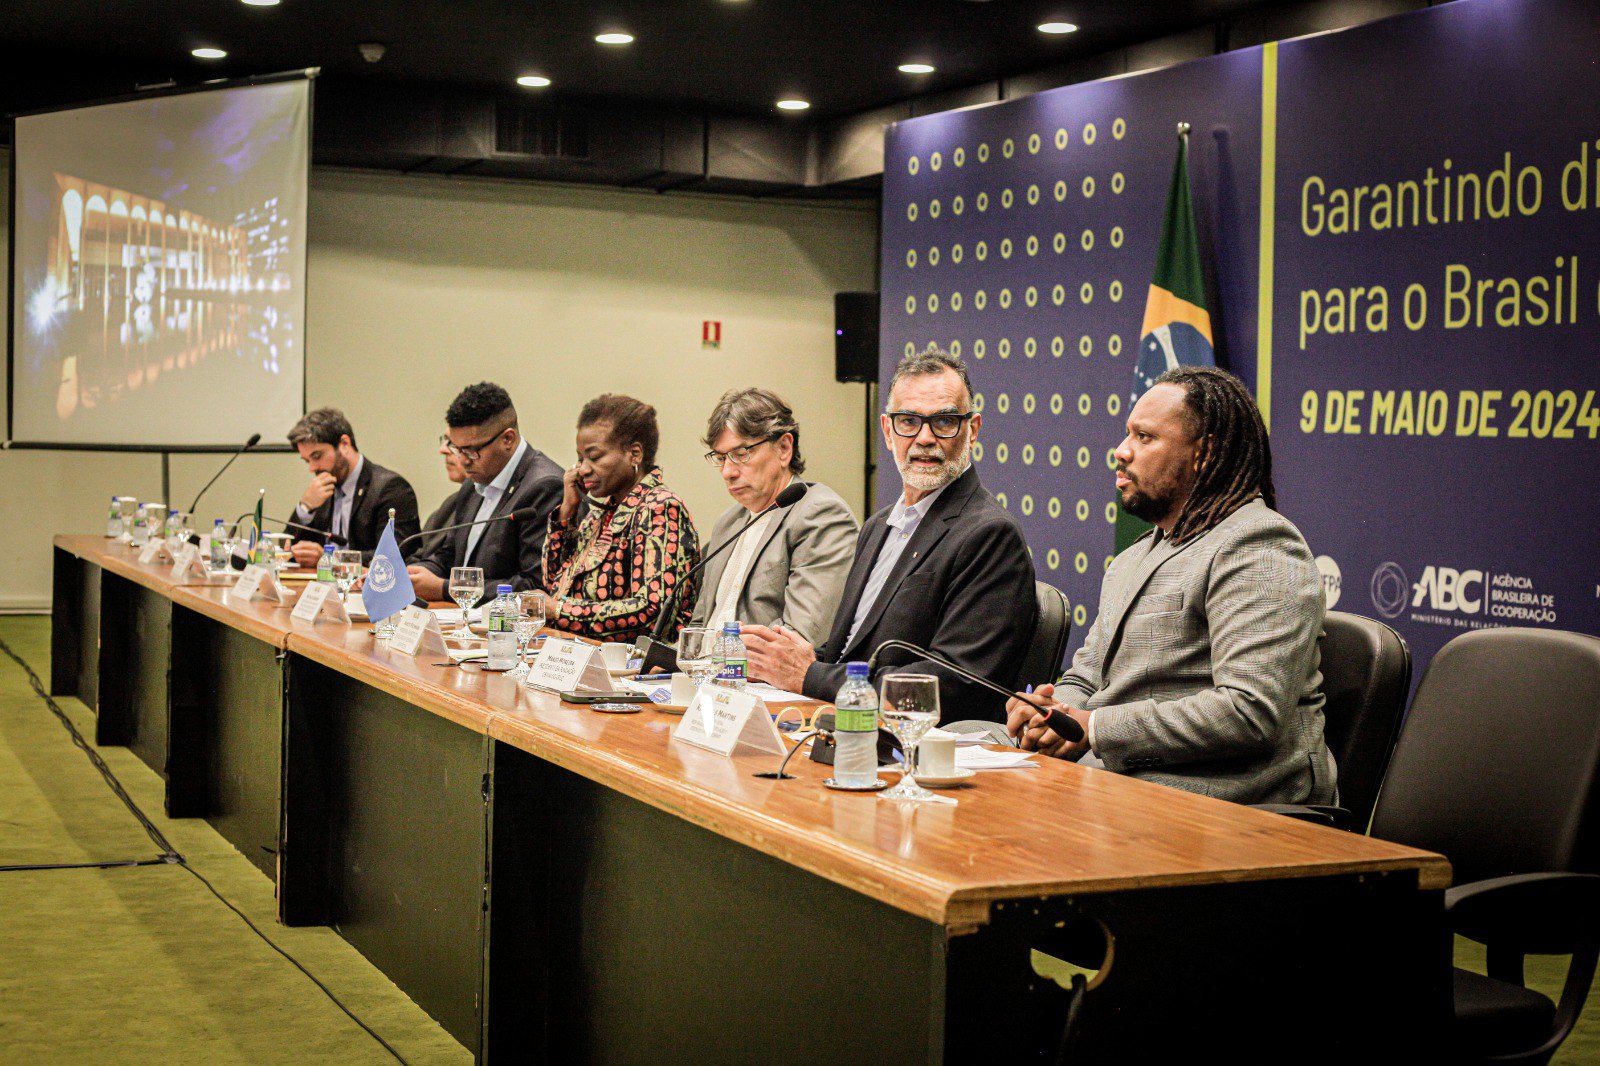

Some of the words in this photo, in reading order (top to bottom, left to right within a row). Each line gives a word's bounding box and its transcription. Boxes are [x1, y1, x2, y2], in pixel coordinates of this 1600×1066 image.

[1301, 151, 1542, 237] Garantindo
[1299, 284, 1388, 350] para
[1403, 283, 1428, 331] o
[1444, 256, 1578, 329] Brasil
[1300, 390, 1319, 434] 9
[1323, 390, 1366, 435] DE
[1369, 390, 1449, 436] MAIO
[1455, 390, 1503, 437] DE
[1507, 390, 1600, 439] 2024
[1412, 565, 1483, 614] ABC
[1491, 574, 1533, 589] AGÊNCIA
[1491, 590, 1539, 605] BRASILEIRA
[1541, 594, 1554, 607] DE
[1491, 605, 1557, 623] COOPERAÇÃO
